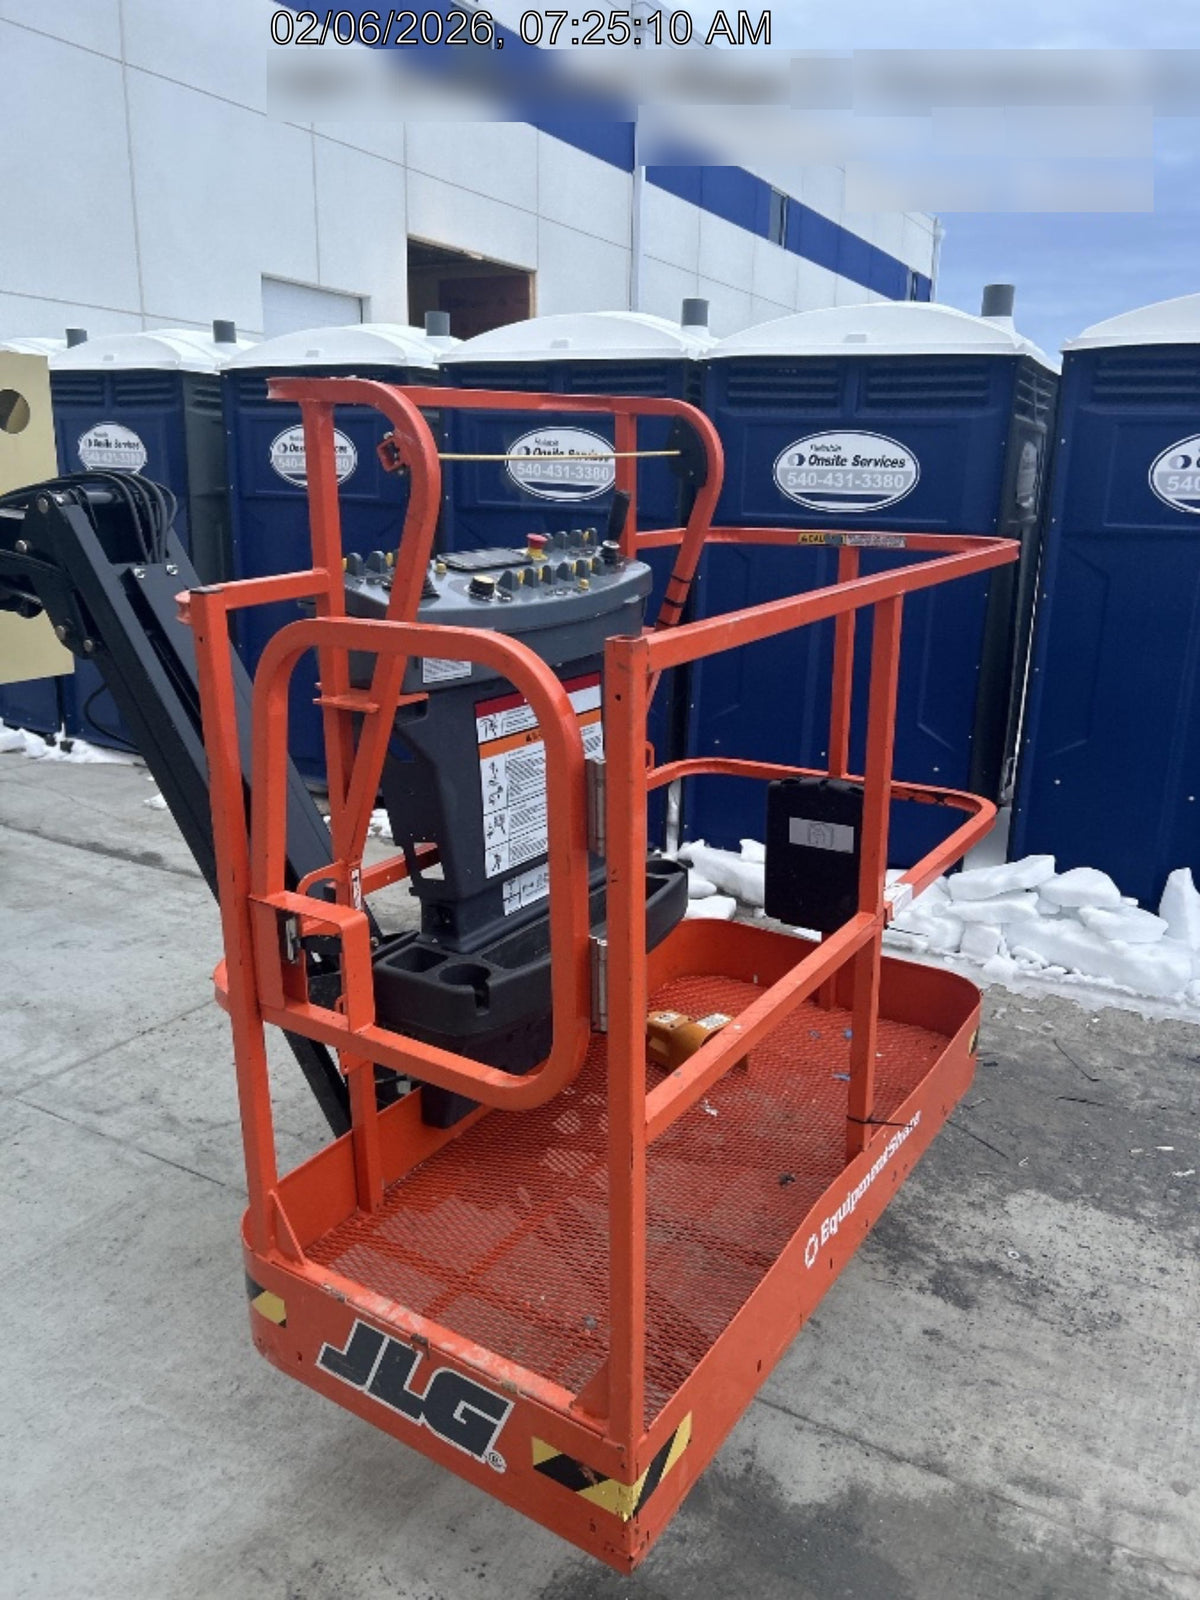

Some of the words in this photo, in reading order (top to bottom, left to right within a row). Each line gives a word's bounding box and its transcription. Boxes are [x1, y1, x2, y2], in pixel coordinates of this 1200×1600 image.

[808, 454, 849, 467] Onsite
[851, 454, 906, 469] Services
[516, 462, 609, 481] 540-431-3380
[787, 471, 905, 489] 540-431-3380
[315, 1318, 515, 1463] JLG
